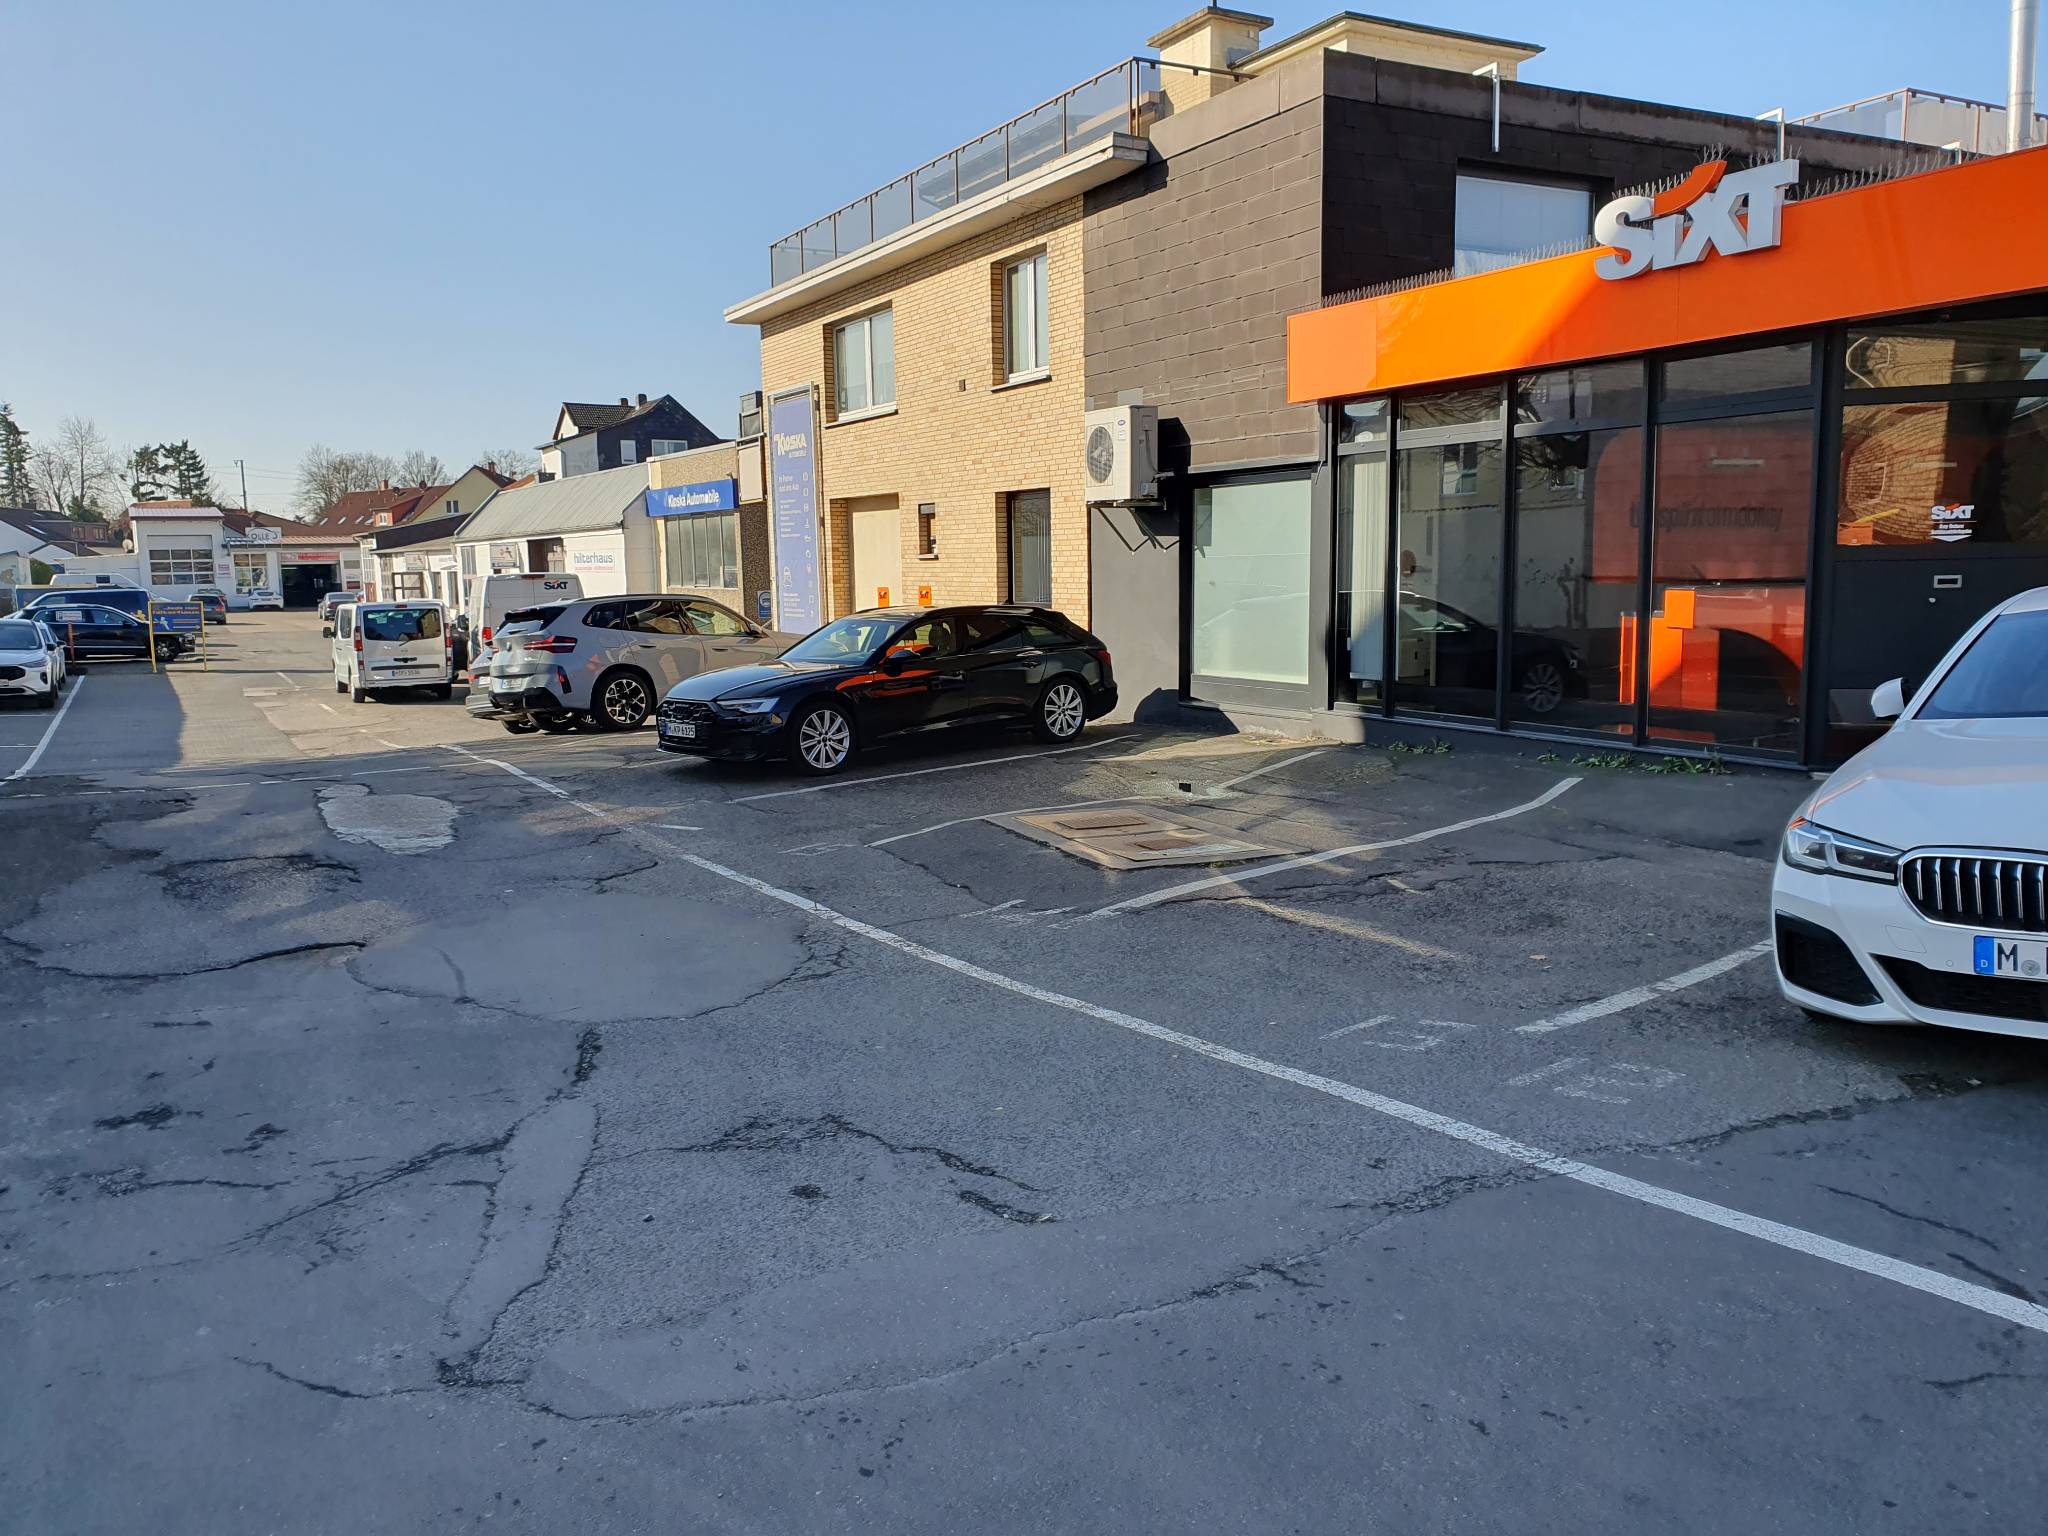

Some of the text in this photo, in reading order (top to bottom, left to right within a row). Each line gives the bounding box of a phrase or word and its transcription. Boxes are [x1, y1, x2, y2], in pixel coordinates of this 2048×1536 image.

[1594, 159, 1800, 281] SIXT
[1931, 503, 1975, 519] SIXT
[544, 578, 568, 590] SIXT
